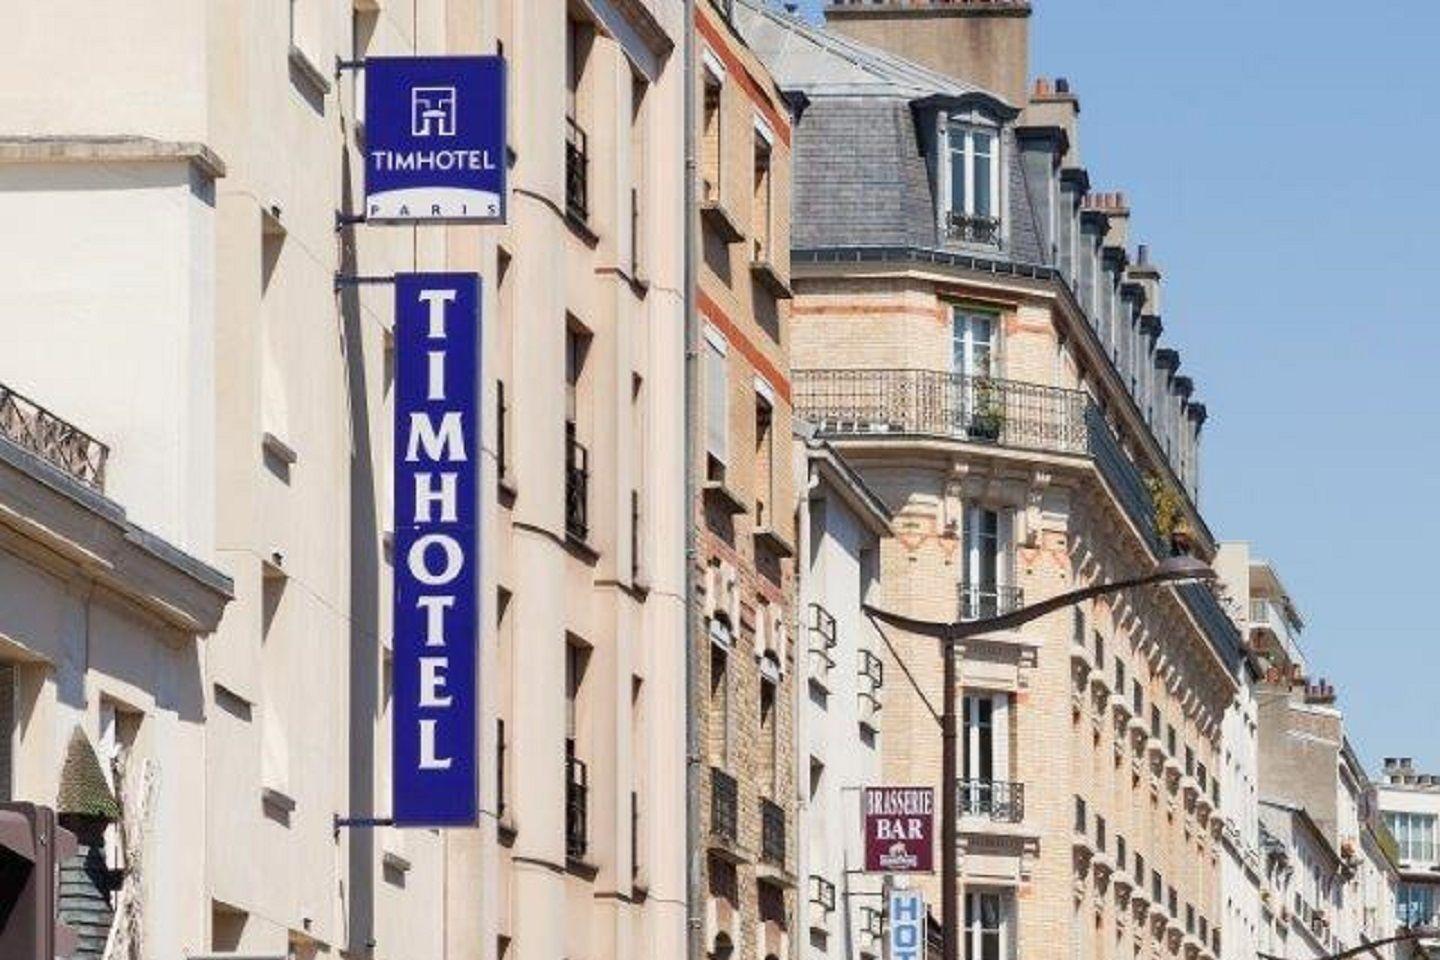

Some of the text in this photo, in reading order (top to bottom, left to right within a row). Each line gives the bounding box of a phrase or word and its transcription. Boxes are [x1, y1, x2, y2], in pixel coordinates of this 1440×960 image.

[371, 150, 496, 170] TIMHOTEL
[371, 204, 497, 216] PARIS
[405, 289, 468, 769] TIMHOTEL
[867, 788, 933, 816] BRASSERIE
[876, 819, 923, 840] BAR
